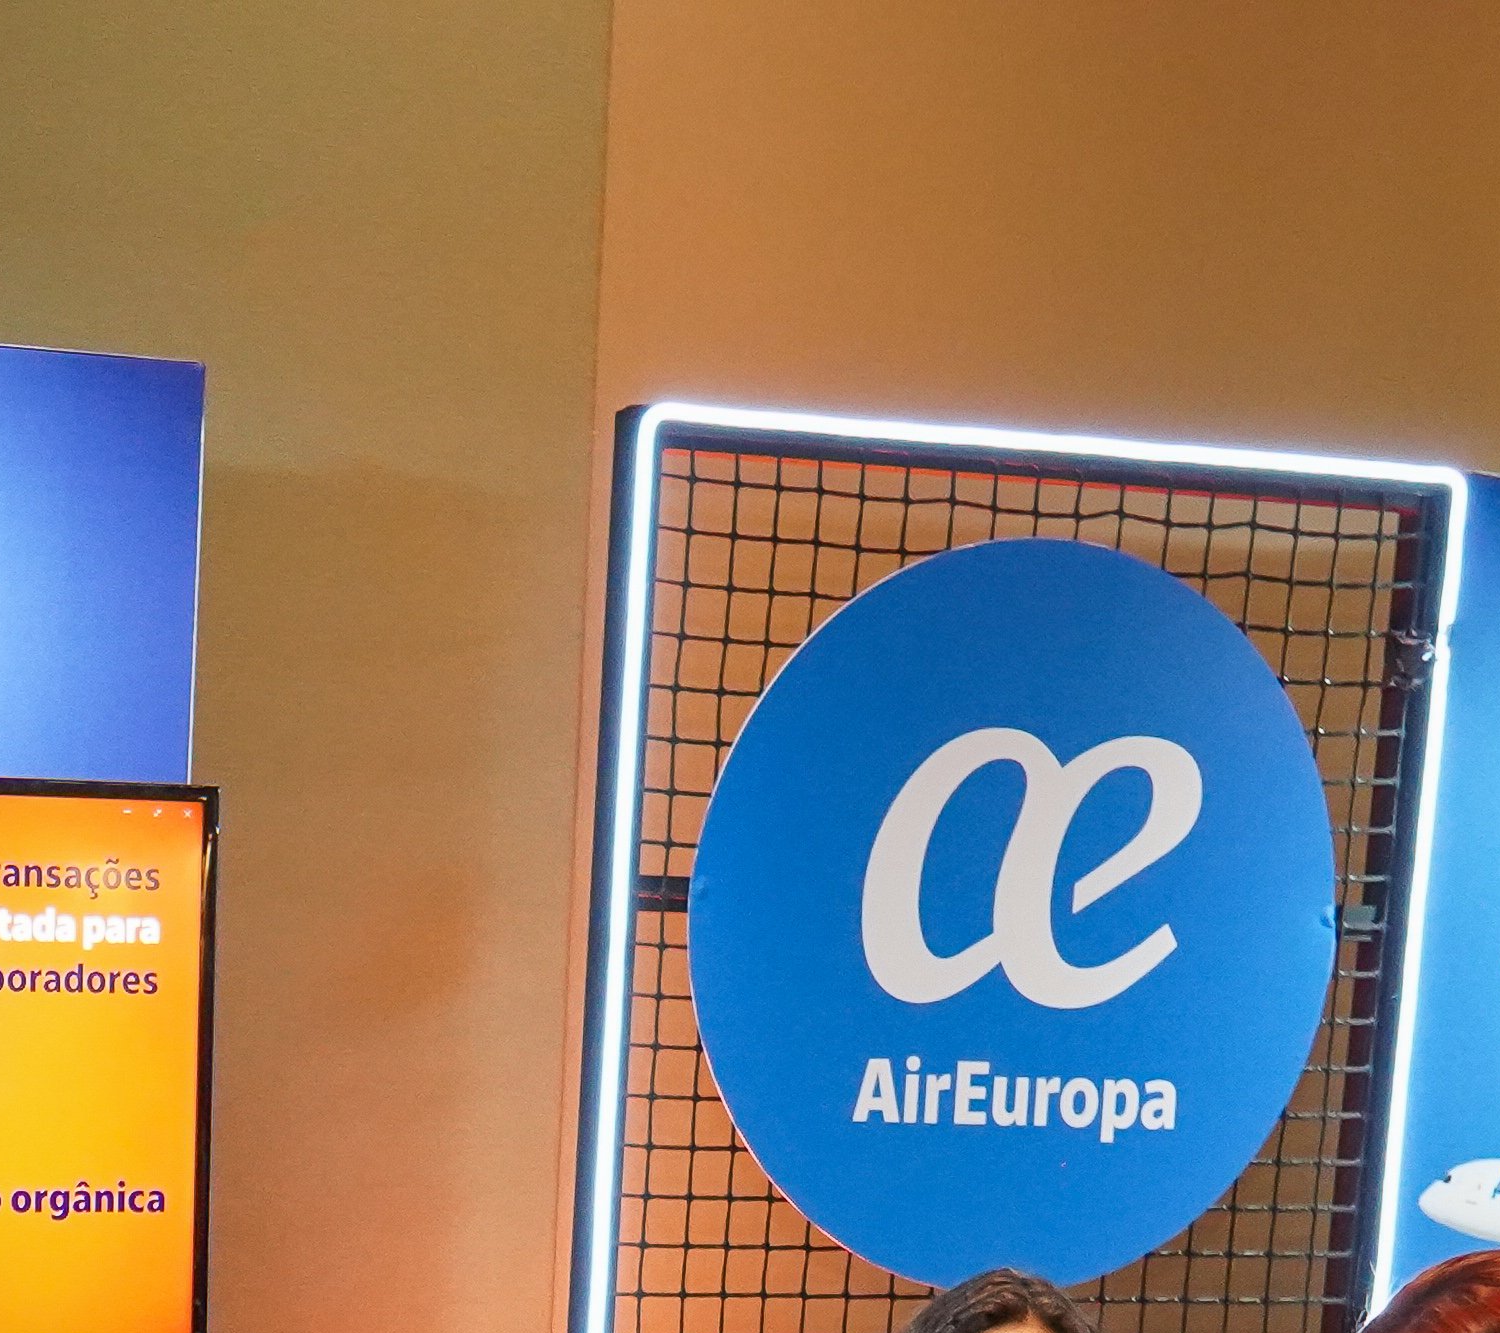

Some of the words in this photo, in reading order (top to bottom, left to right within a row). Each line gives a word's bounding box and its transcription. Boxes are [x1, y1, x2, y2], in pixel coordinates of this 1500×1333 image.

[82, 914, 161, 951] para
[852, 1055, 1178, 1143] AirEuropa
[10, 1180, 166, 1221] orgânica
